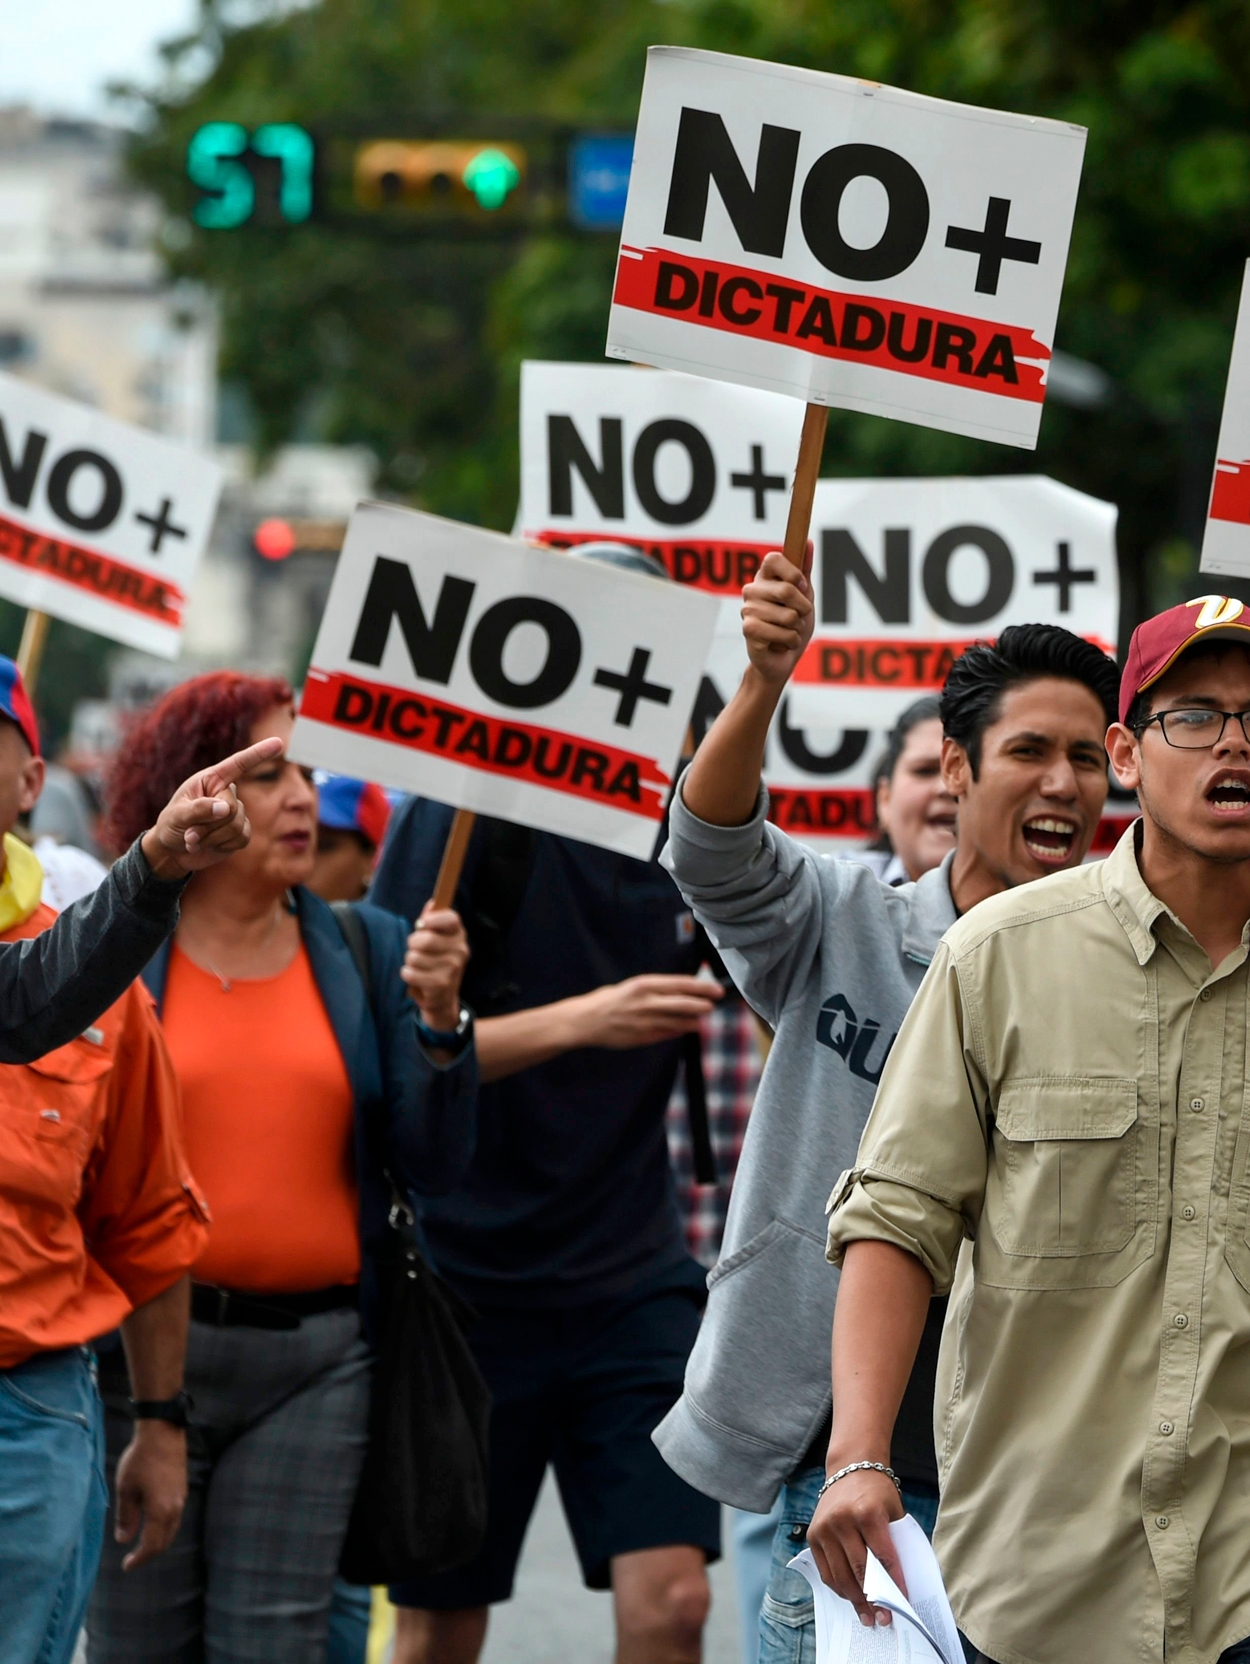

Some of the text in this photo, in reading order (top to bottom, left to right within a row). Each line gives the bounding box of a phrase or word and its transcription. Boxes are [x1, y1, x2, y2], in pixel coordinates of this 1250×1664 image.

[187, 121, 315, 230] 57
[653, 261, 1020, 387] DICTADURA
[333, 683, 643, 804] DICTADURA
